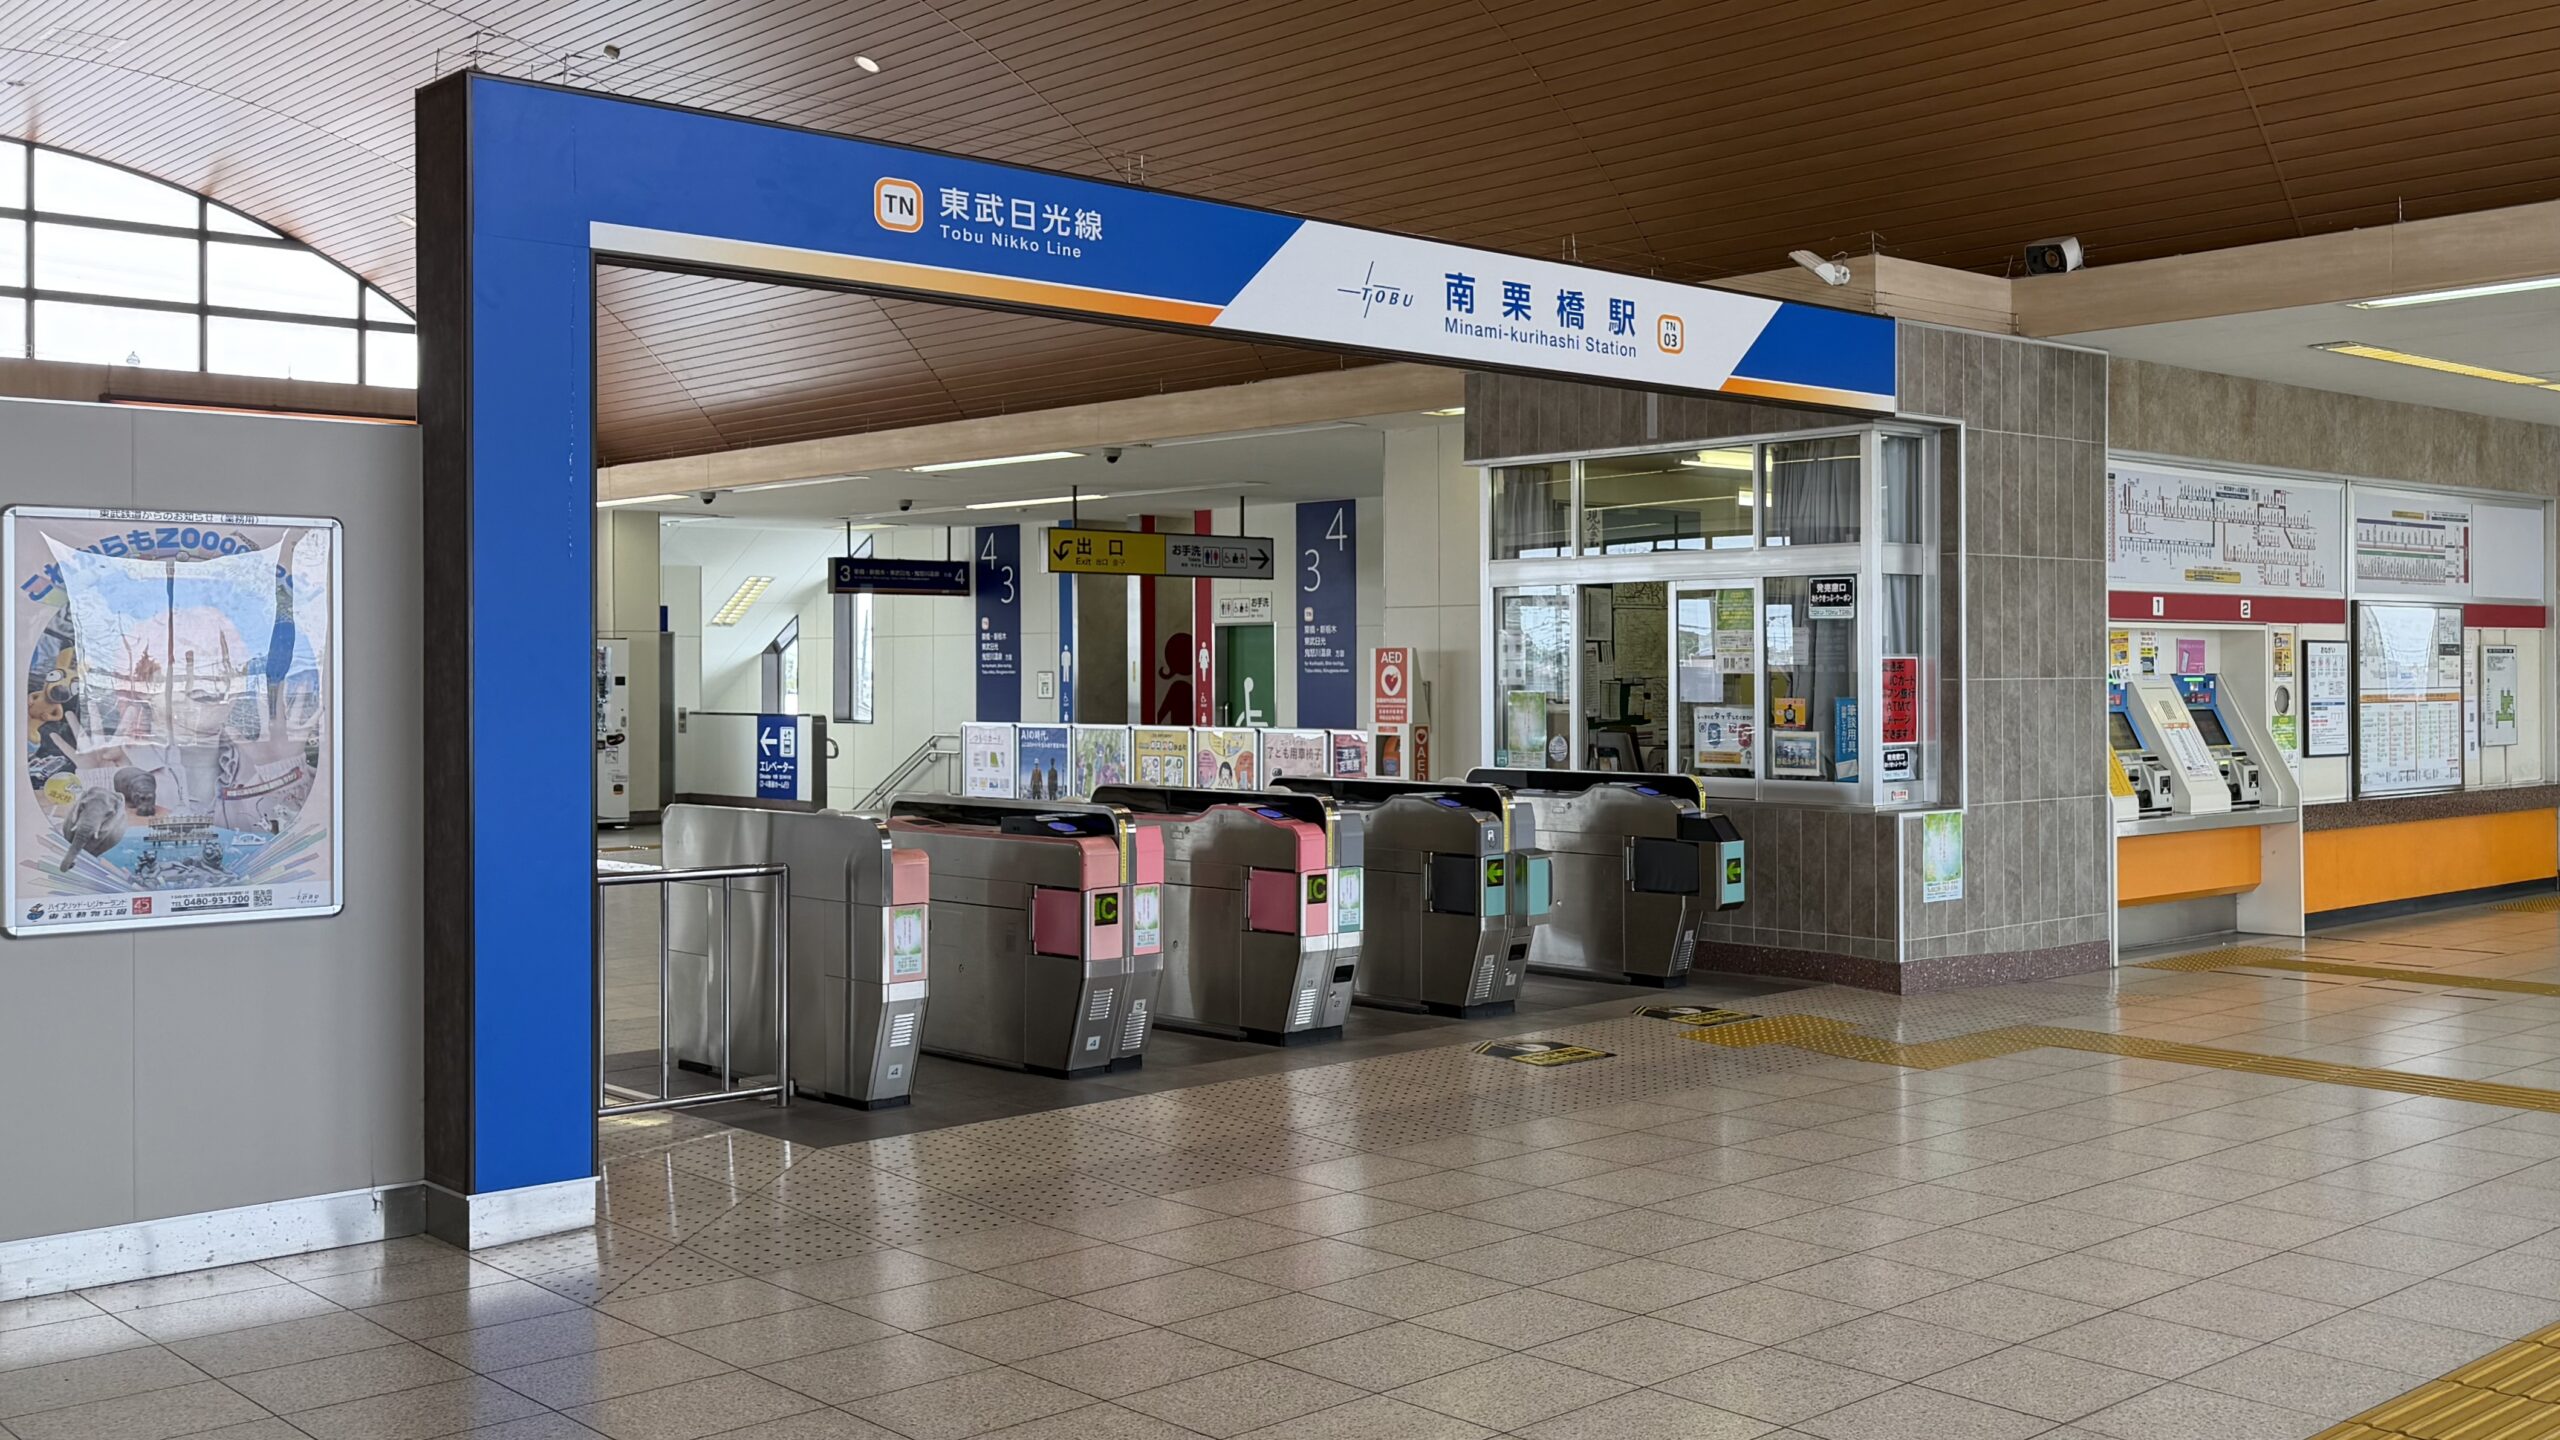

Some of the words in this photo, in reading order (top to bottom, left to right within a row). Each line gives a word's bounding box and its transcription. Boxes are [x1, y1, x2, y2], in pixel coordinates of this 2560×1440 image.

[884, 194, 914, 216] TN
[939, 187, 1103, 241] 東武日光線
[939, 225, 984, 244] Tobu
[991, 232, 1039, 252] Nikko
[1047, 240, 1082, 259] Line
[1444, 272, 1636, 338] 南栗橋駅
[1664, 320, 1677, 332] TN
[1444, 317, 1580, 351] Minami-kurihashi
[1585, 336, 1638, 358] Station
[1663, 333, 1678, 348] 03
[1325, 507, 1348, 551] 4
[980, 532, 998, 570] 4
[1077, 537, 1123, 556] 出口
[1171, 544, 1201, 556] お手洗
[1076, 558, 1091, 566] Exit
[1304, 549, 1321, 592] 3
[840, 565, 851, 582] 3
[955, 568, 965, 585] 4
[1001, 566, 1015, 603] 3
[2155, 599, 2161, 613] 1
[2242, 602, 2249, 616] 2
[1381, 652, 1403, 663] AED
[759, 761, 795, 773] エレベーター
[1417, 746, 1426, 781] AED
[1306, 877, 1327, 901] IC
[134, 898, 150, 911] 45
[184, 895, 249, 907] 0480-93-1200
[1095, 897, 1117, 920] IC
[1136, 1001, 1143, 1010] 3
[1089, 1039, 1097, 1048] 4
[890, 1067, 898, 1076] 4
